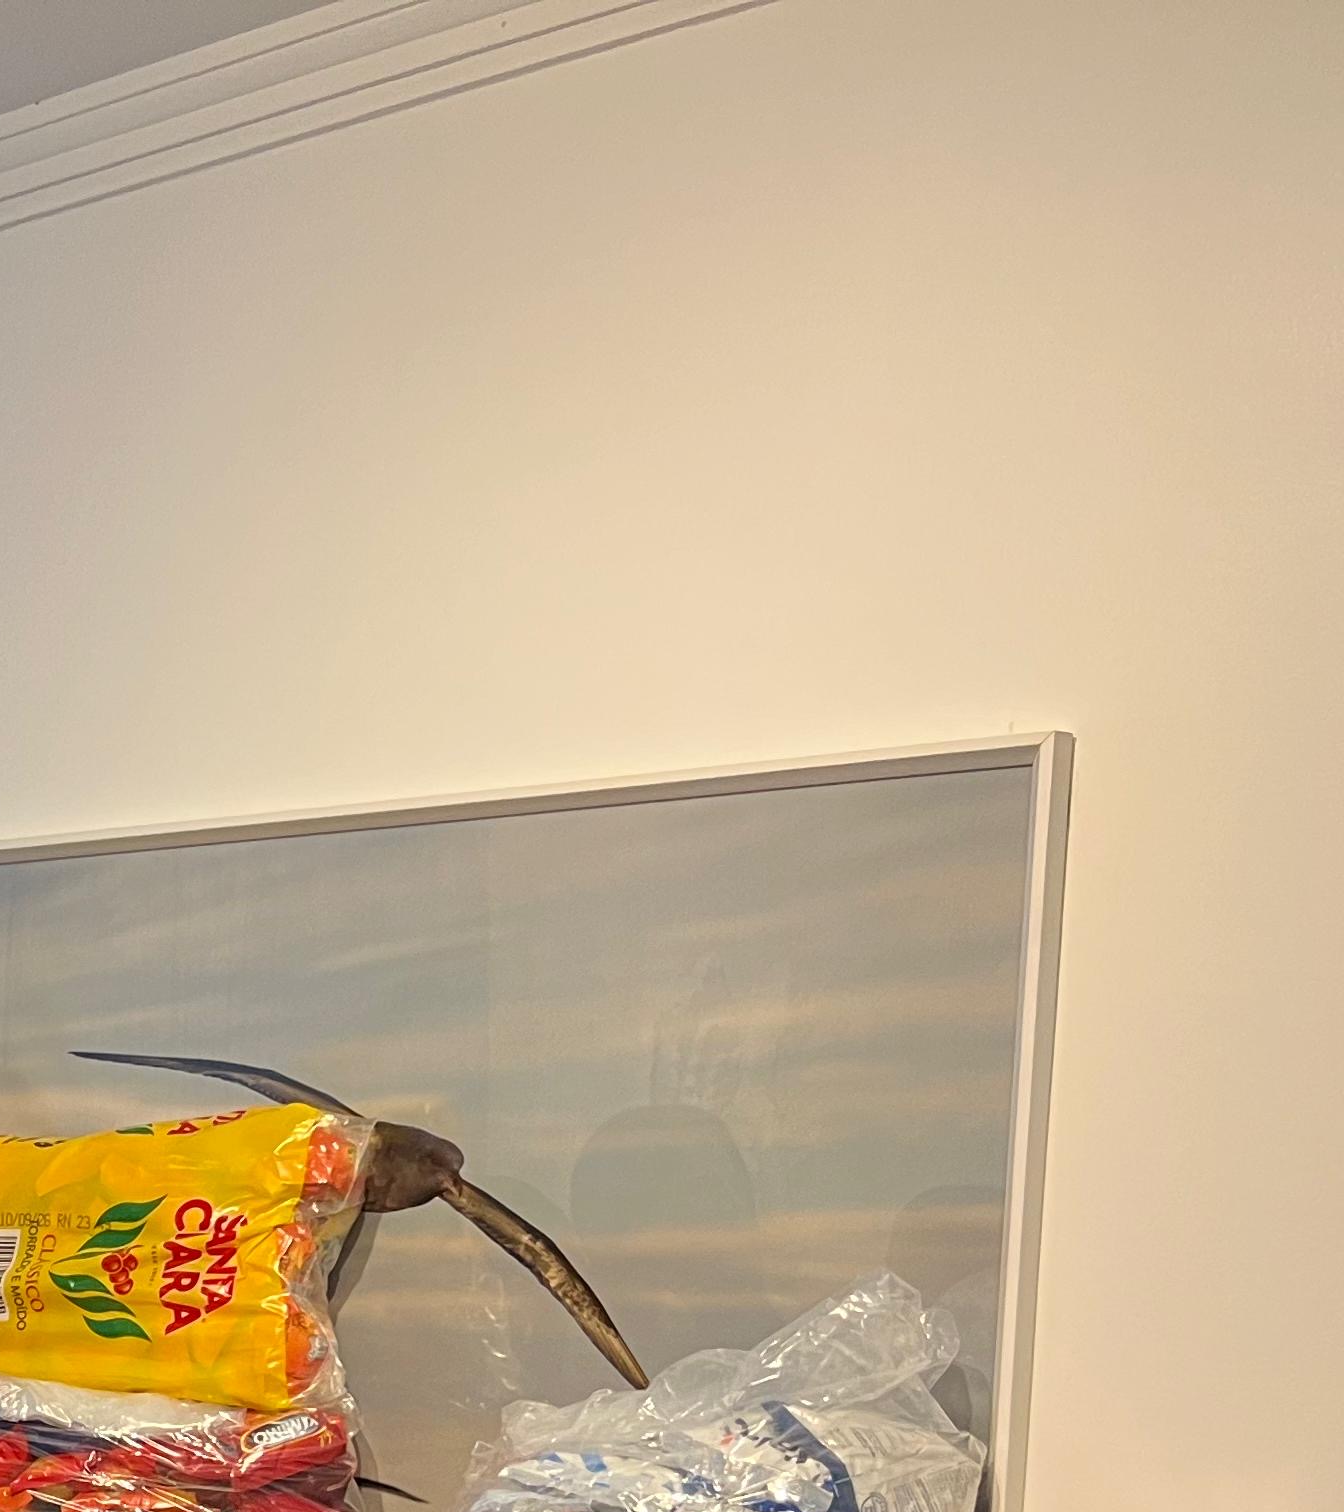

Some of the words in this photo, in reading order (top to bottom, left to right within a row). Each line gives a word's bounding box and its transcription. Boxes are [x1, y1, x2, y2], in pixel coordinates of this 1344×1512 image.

[9, 1285, 27, 1332] MOÍDO
[25, 1233, 57, 1314] CLÁSSICO
[159, 1198, 213, 1337] CLARA
[205, 1213, 248, 1315] SANTA
